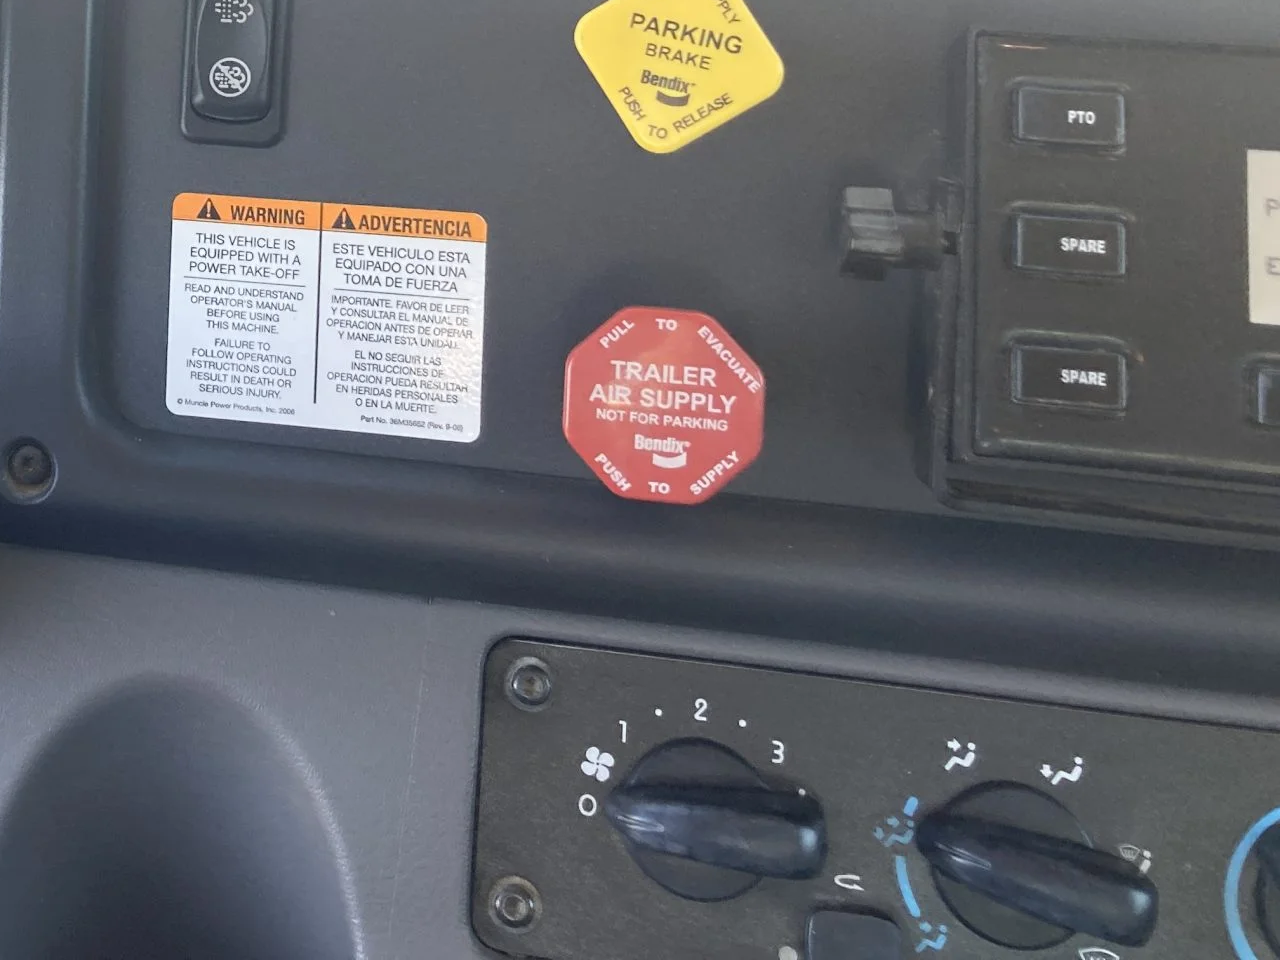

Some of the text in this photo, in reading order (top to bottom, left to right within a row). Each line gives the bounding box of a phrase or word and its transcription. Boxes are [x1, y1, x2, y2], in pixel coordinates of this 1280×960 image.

[629, 12, 743, 55] PARKING
[645, 42, 713, 71] BRAKE
[640, 69, 694, 94] Bendix
[618, 85, 735, 140] PUSH TO RELEASE
[1067, 110, 1096, 125] PTO
[230, 205, 305, 225] WARNING
[358, 214, 472, 238] ADVERTENCIA
[196, 232, 296, 251] THIS VEHICLE IS
[1060, 237, 1107, 255] SPARE
[190, 247, 301, 266] EQUIPPED WITH A
[332, 243, 471, 264] ESTE VEHICULO ESTA
[189, 261, 300, 280] POWER TAKE-OFF
[335, 258, 467, 279] EQUIPADO CON UNA
[184, 283, 304, 301] READ AND UNDERSTAND
[344, 273, 458, 293] TOMA DE FUERZA
[190, 295, 298, 313] OPERATOR'S MANUAL
[396, 300, 469, 315] FAVOR DE LEER
[206, 308, 280, 323] BEFORE USING
[206, 320, 229, 330] THIS
[331, 307, 469, 327] Y CONSULTAR EL MANUAL DE
[326, 318, 473, 339] OPERACION ANTES DE OPERAR
[338, 331, 418, 346] Y MANEJAR ESTA
[214, 338, 271, 351] FAILURE TO
[191, 348, 292, 365] FOLLOW OPERATING
[354, 350, 442, 367] EL NO SEGUIR LAS
[599, 318, 762, 394] PULL TO EVACUATE
[186, 359, 297, 377] INSTRUCTIONS COULD
[351, 361, 429, 377] INSTRUCCIONES
[610, 359, 718, 388] TRAILER
[190, 371, 292, 389] RESULT IN DEATH OR
[326, 371, 469, 393] OPERACION PUEDA RESULTAR
[1060, 369, 1108, 388] SPARE
[199, 383, 282, 400] SERIOUS INJURY.
[336, 384, 459, 404] EN HERIDAS PERSONALES
[589, 383, 738, 415] AIR SUPPLY
[184, 398, 232, 410] Muncie Power
[355, 398, 363, 407] O
[365, 398, 379, 408] EN
[381, 400, 393, 410] LA
[360, 414, 374, 423] Part
[595, 407, 729, 432] NOT FOR PARKING
[634, 433, 689, 454] Bendix
[594, 450, 740, 496] PUSH TO SUPPLY
[693, 698, 708, 722] 2
[618, 720, 628, 743] 1
[771, 741, 786, 764] 3
[578, 794, 598, 816] 0
